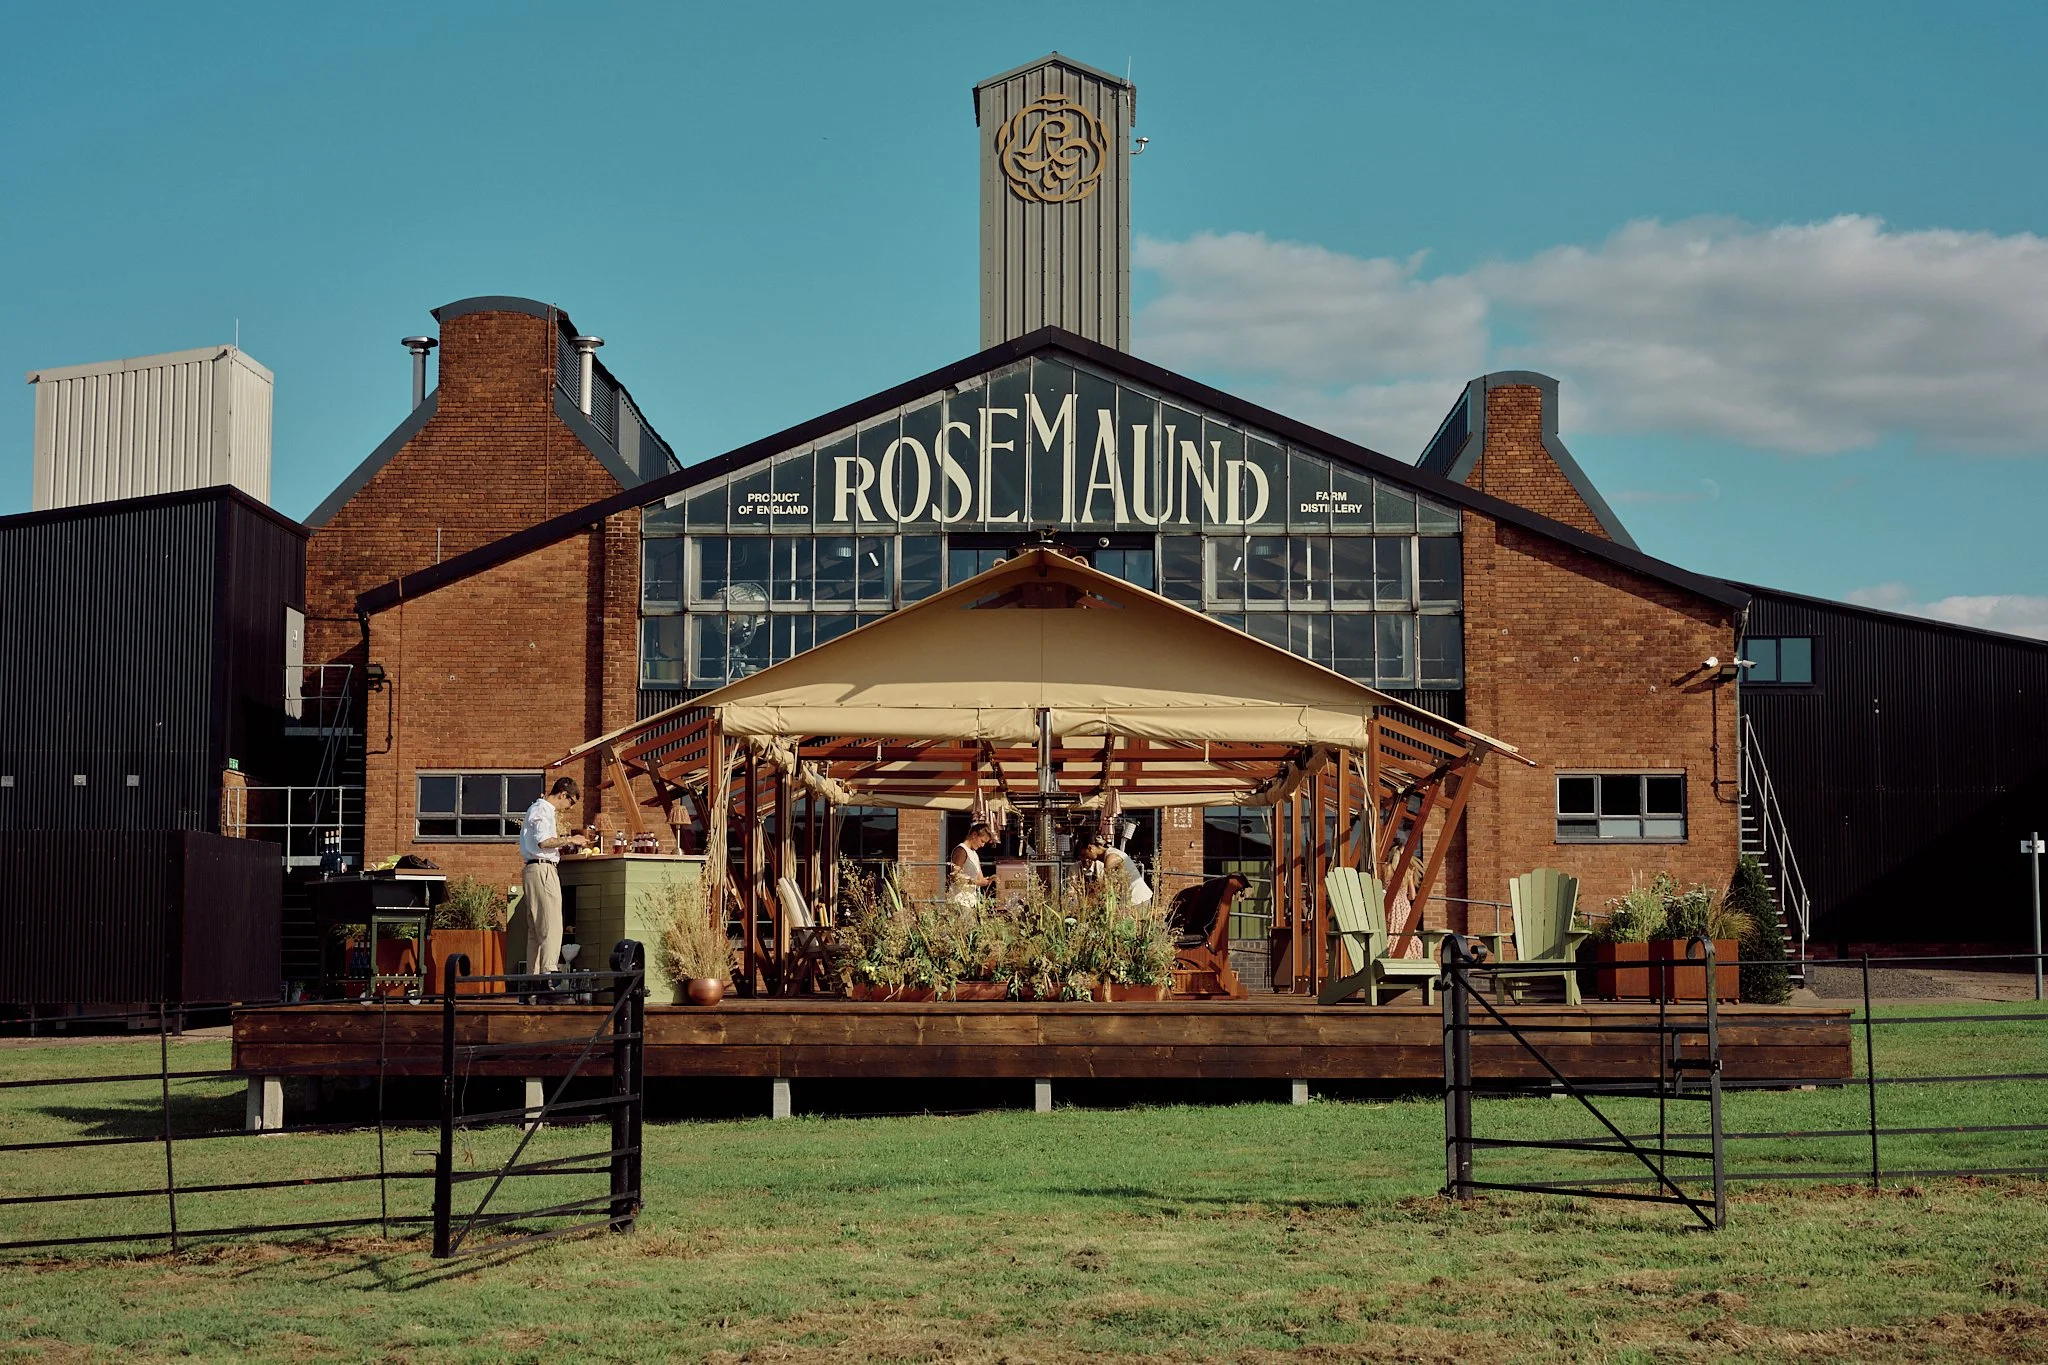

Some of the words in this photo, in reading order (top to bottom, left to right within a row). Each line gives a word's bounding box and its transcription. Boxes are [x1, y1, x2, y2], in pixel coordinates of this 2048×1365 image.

[832, 393, 1270, 525] ROSEMAUND
[747, 493, 800, 503] PRODUCT
[1315, 491, 1347, 501] FARM
[737, 505, 754, 515] OF
[756, 505, 809, 515] ENGLAND
[1300, 503, 1363, 514] DISTILLERY
